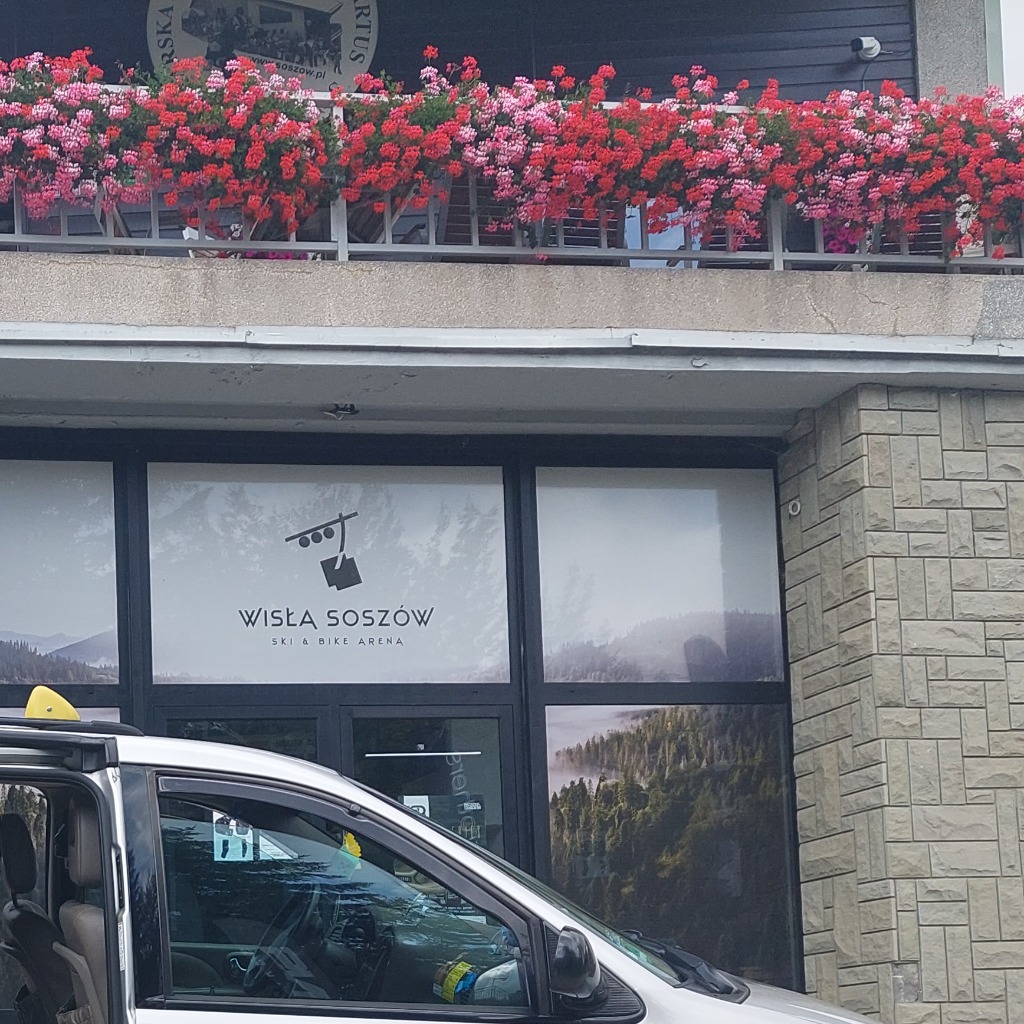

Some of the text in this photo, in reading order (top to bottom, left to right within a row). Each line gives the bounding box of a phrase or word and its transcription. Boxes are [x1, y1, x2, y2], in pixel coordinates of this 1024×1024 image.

[248, 55, 326, 79] wwwsoszow.pl
[238, 604, 435, 630] WISŁA SOSZÓW
[272, 636, 404, 646] SKI & BIKE ARENA
